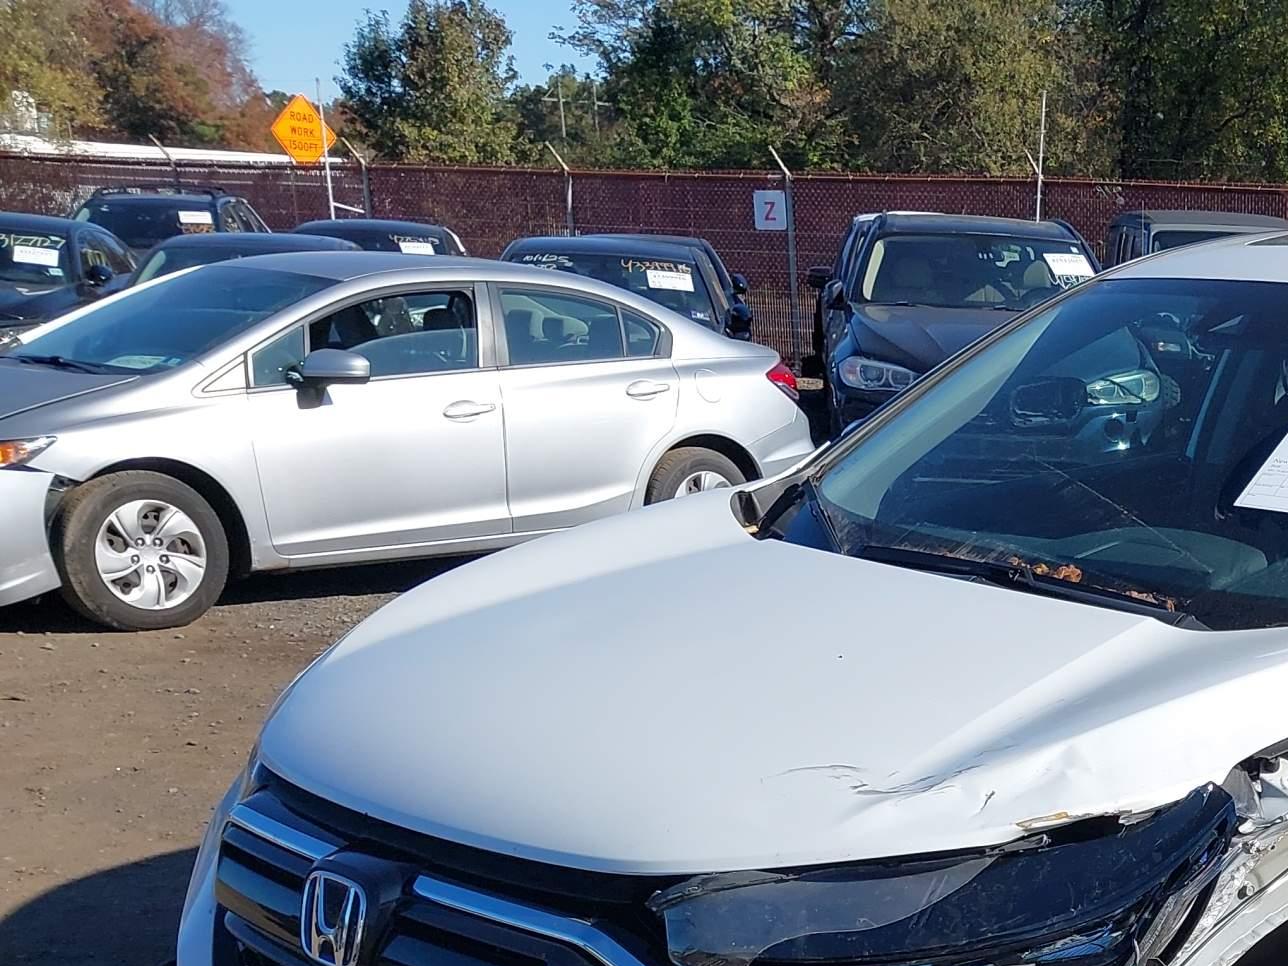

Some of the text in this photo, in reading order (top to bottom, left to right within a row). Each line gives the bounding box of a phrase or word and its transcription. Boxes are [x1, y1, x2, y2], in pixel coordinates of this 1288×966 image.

[289, 111, 314, 124] ROAD
[289, 126, 316, 138] WORK
[764, 201, 777, 221] Z
